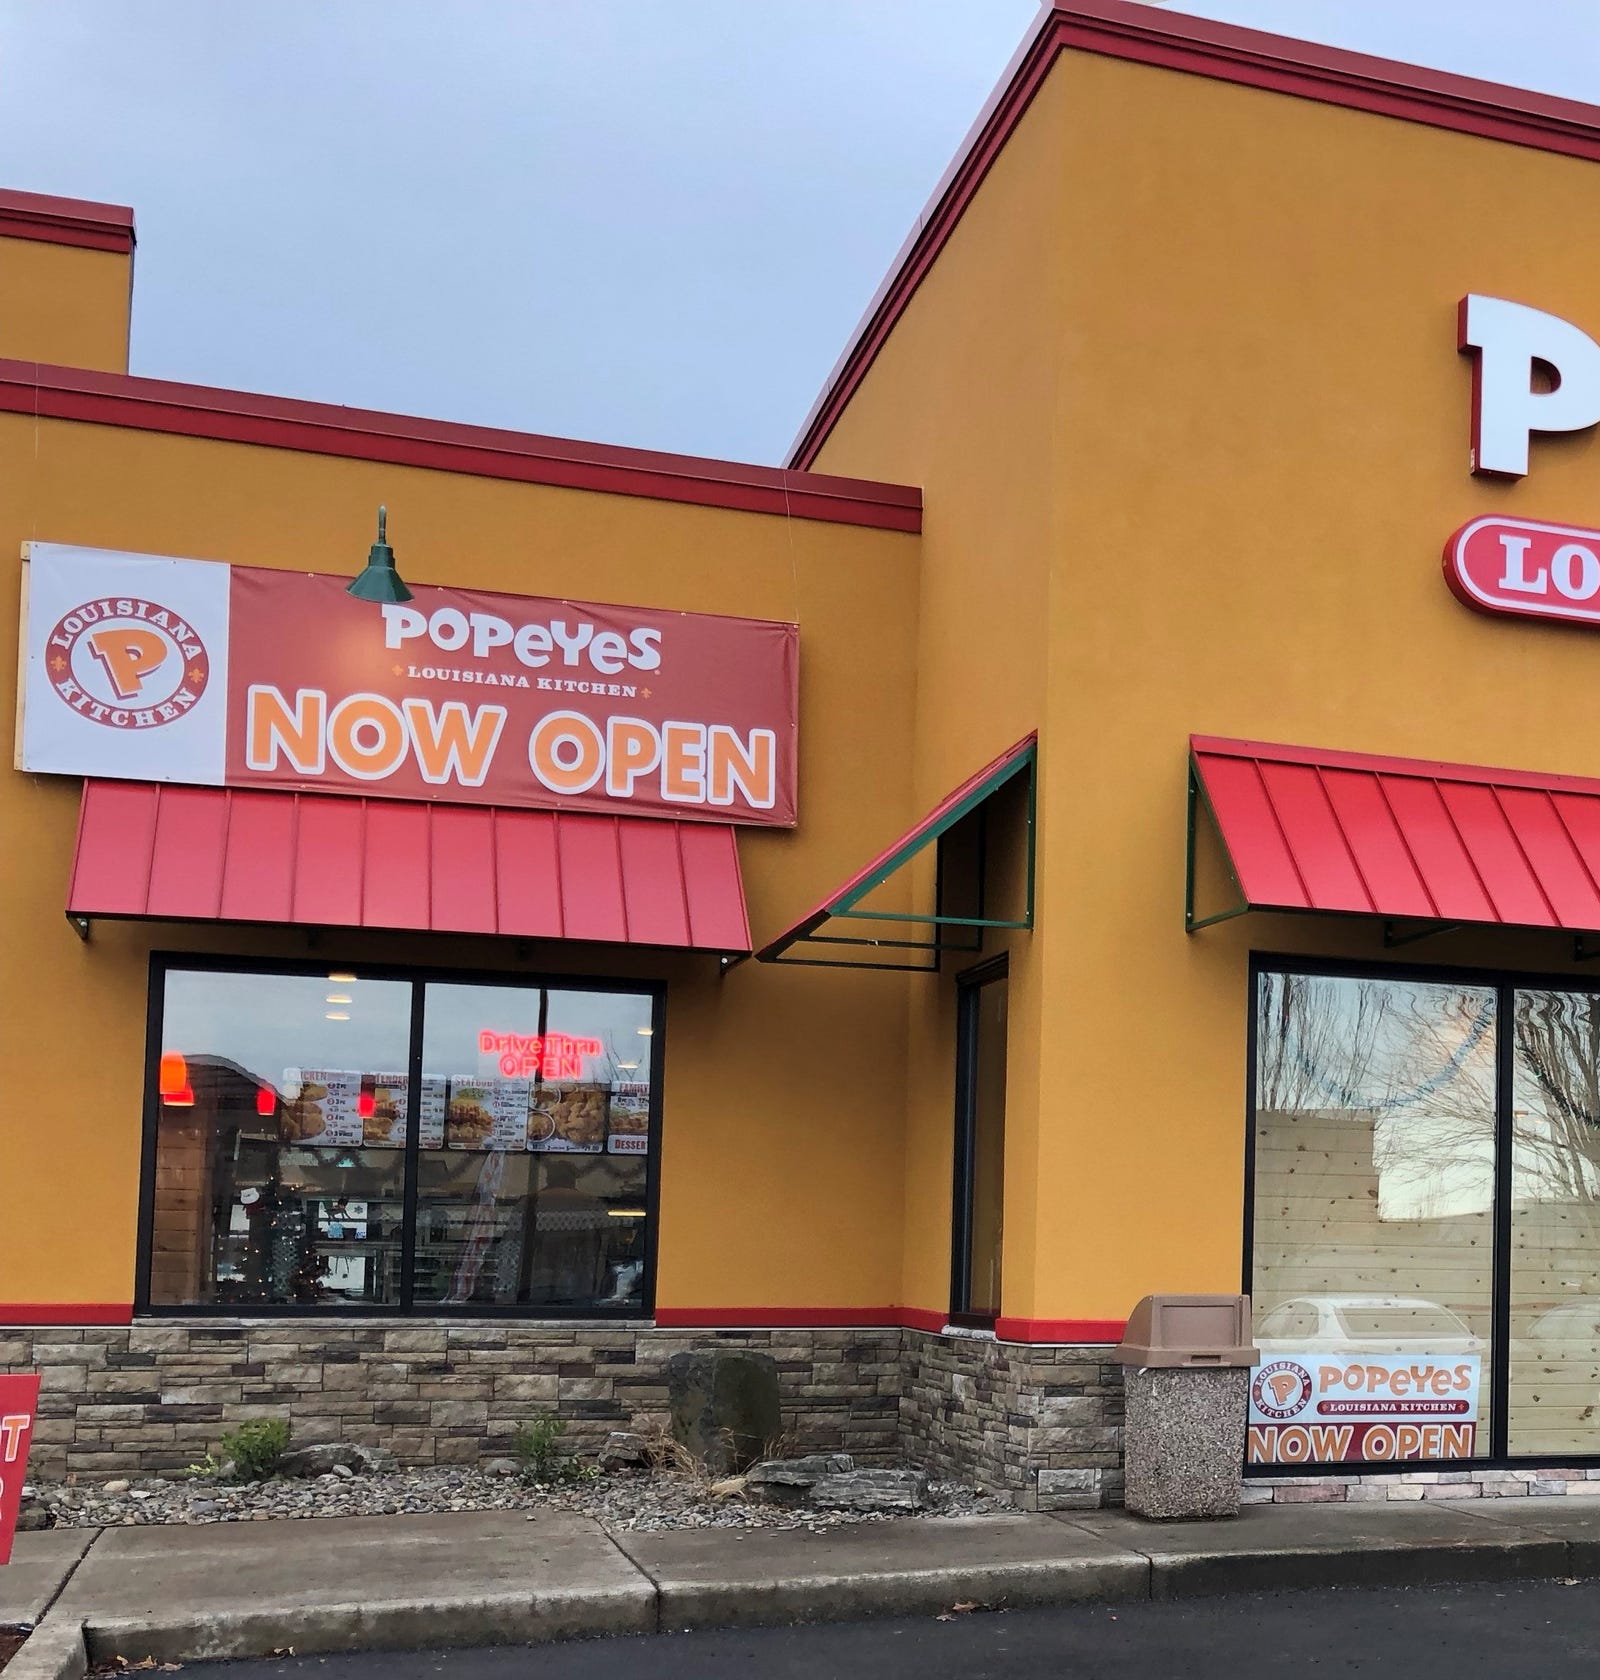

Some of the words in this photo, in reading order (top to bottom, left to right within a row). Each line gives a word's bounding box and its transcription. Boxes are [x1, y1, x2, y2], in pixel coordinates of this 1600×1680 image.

[51, 600, 202, 660] LOUISIANA
[408, 666, 530, 688] LOUISIANA
[536, 677, 638, 698] KITCHEN
[56, 678, 196, 727] KITCHEN
[247, 684, 507, 787] NOW
[528, 710, 775, 809] OPEN
[545, 1036, 599, 1057] Thru
[500, 1055, 581, 1079] OPEN
[1255, 1361, 1310, 1386] LOUISIANA
[1256, 1398, 1307, 1419] KITCHEN
[1330, 1403, 1397, 1412] LOUISIANA
[1400, 1402, 1457, 1412] KITCHEN
[1248, 1426, 1354, 1463] NOW
[1362, 1424, 1470, 1461] OPEN
